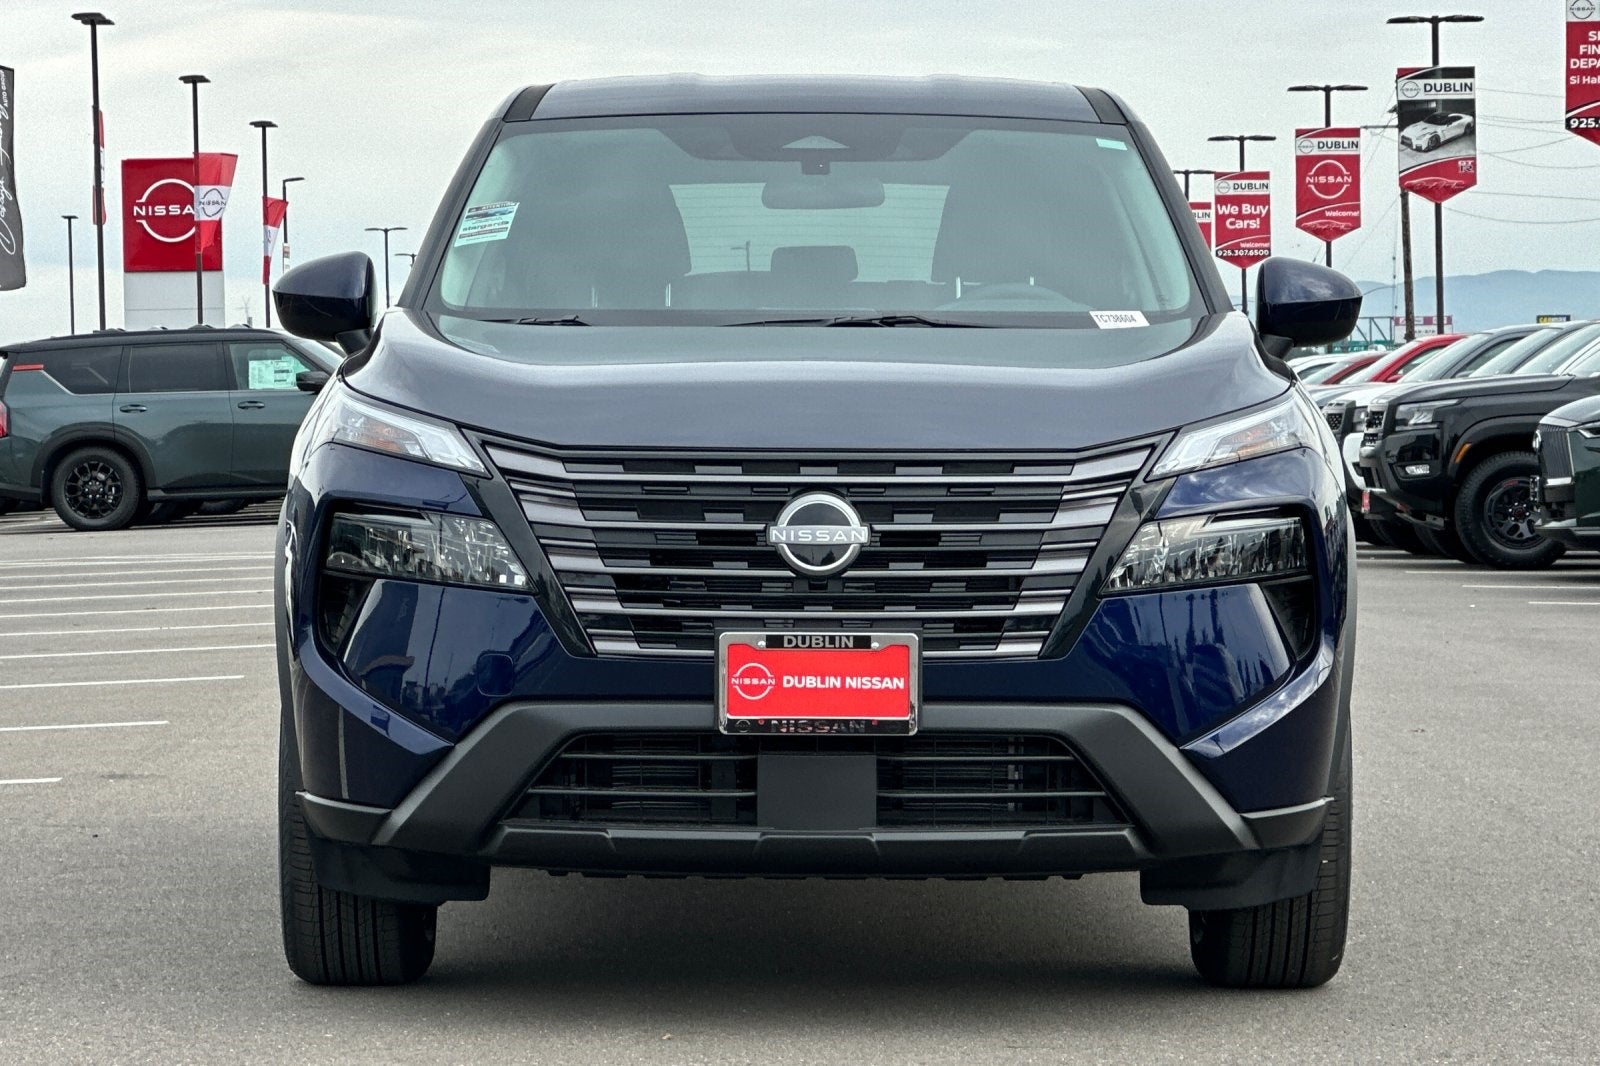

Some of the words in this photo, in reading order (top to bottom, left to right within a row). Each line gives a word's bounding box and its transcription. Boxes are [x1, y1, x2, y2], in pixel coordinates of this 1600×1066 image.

[1570, 75, 1580, 84] Si
[1424, 83, 1473, 92] DUBLIN
[1570, 118, 1600, 129] 925.
[1318, 140, 1359, 149] DUBLIN
[1305, 175, 1352, 183] NISSAN
[1233, 182, 1269, 190] DUBLIN
[133, 205, 195, 216] NISSA
[1217, 203, 1239, 215] We
[1242, 203, 1269, 218] Buy
[1226, 217, 1261, 229] Cars!
[772, 529, 865, 542] NISSAN
[783, 635, 854, 648] DUBLIN
[731, 677, 775, 685] NISSAN
[782, 675, 841, 689] DUBLIN
[845, 676, 904, 690] NISSAN
[770, 720, 866, 734] NISSAN
